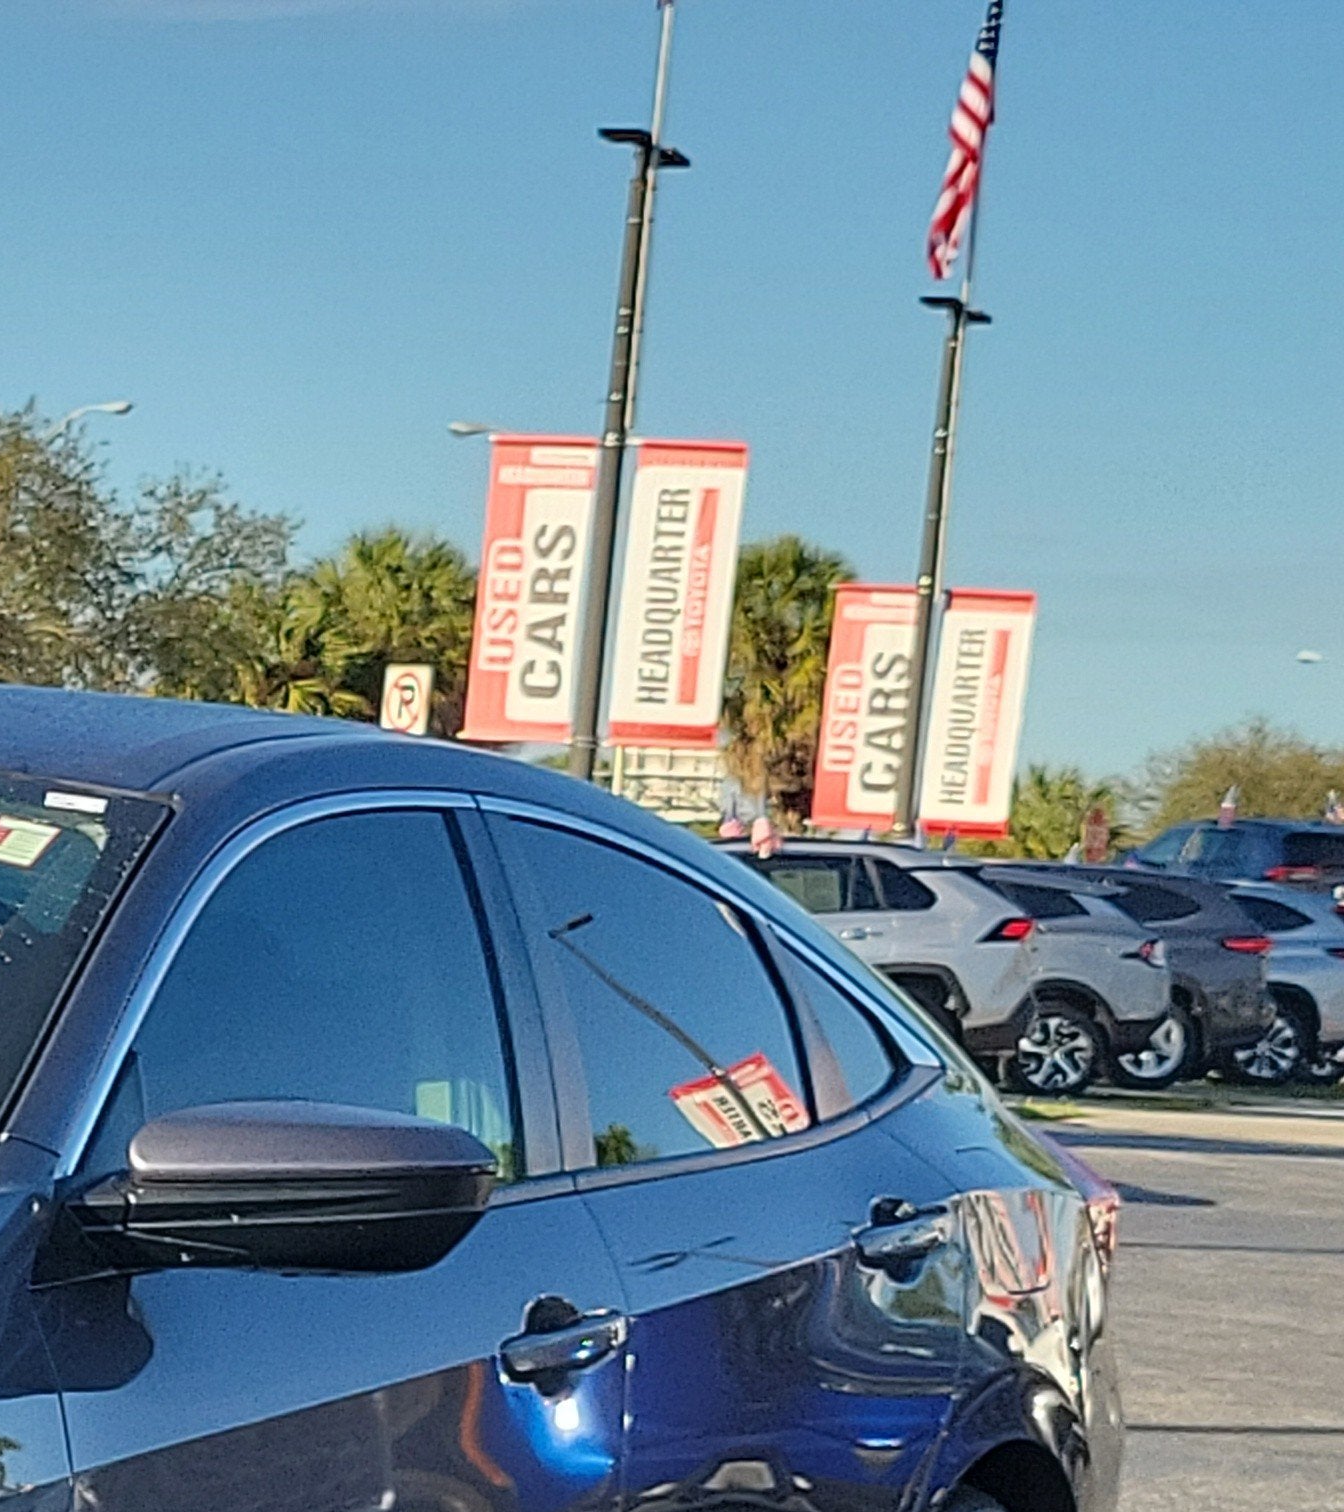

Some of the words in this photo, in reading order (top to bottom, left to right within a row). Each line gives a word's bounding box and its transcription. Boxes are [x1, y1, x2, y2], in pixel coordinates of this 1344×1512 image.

[485, 544, 525, 665] USED
[519, 524, 577, 699] CARS
[635, 488, 691, 704] HEADQUARTER
[827, 668, 863, 766] USED
[861, 652, 911, 793] CARS
[939, 629, 987, 805] HEADQUARTER
